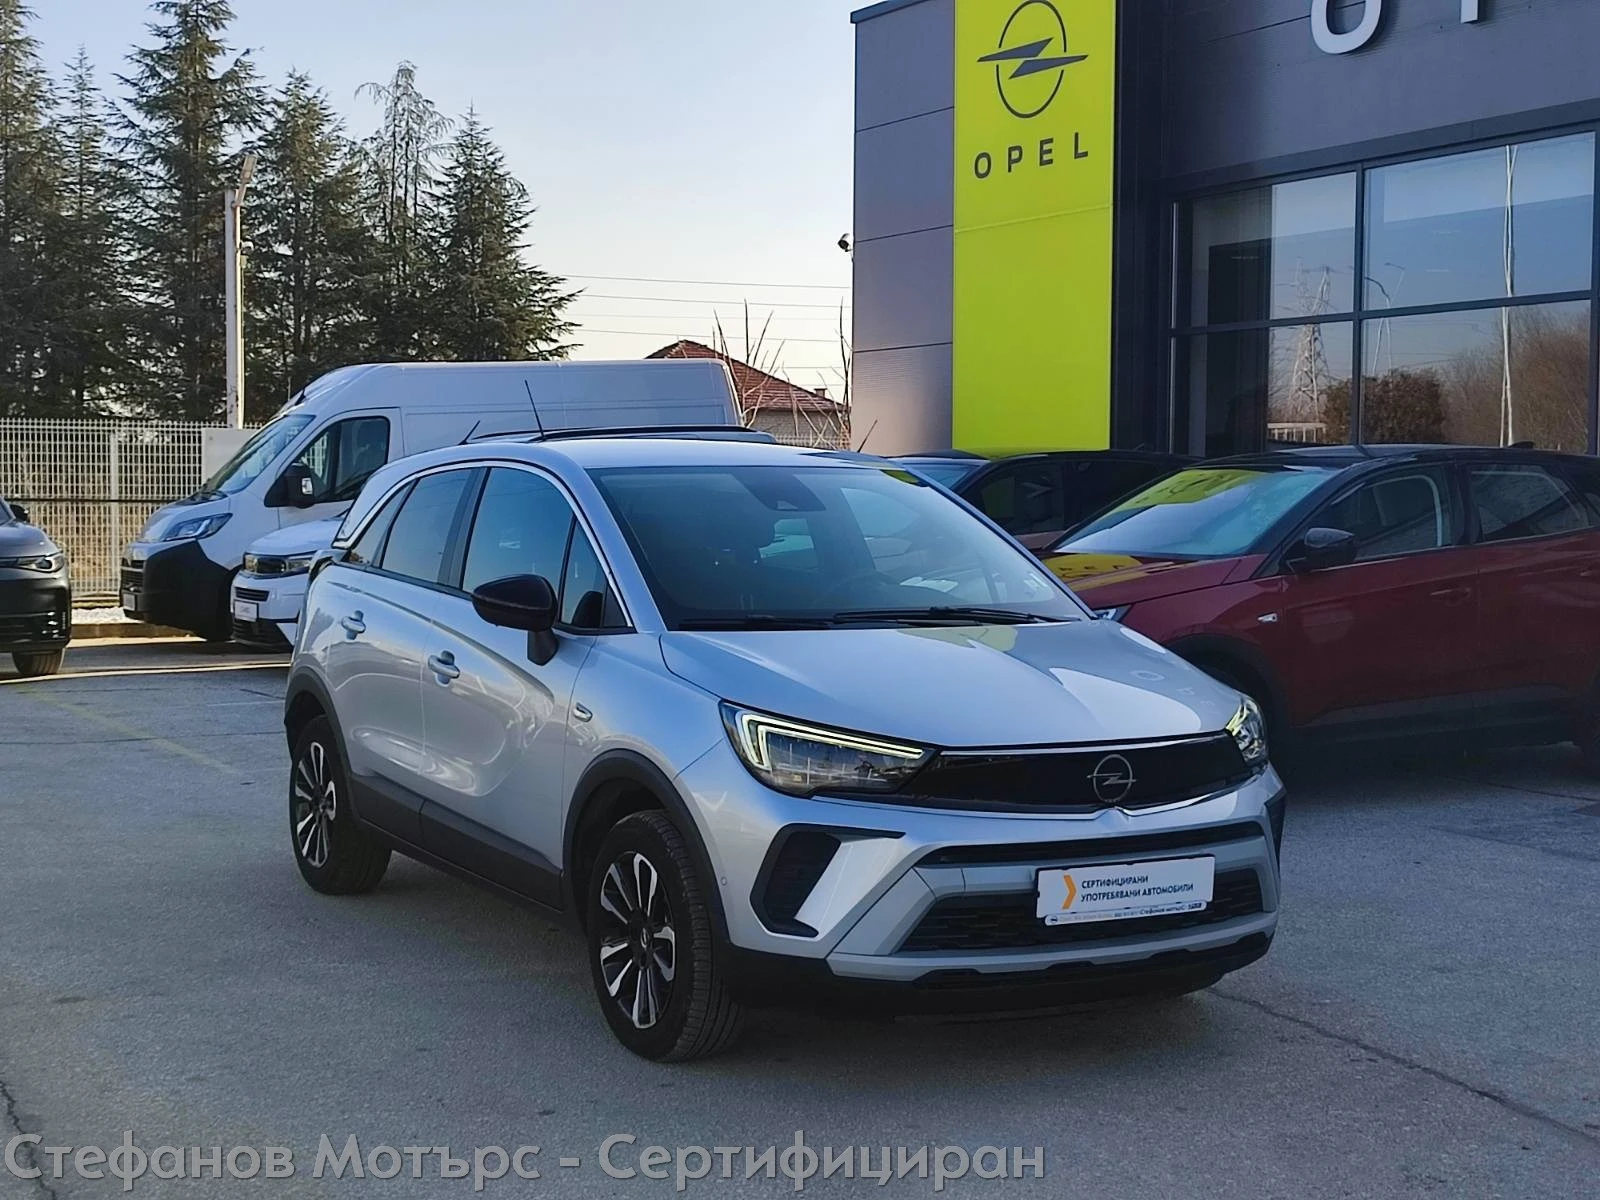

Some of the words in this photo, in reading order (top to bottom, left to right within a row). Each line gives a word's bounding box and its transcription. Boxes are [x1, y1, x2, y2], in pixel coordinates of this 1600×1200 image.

[973, 132, 1089, 180] OPEL
[1081, 875, 1149, 889] СЕРТИФИЦИРАНИ
[1081, 889, 1141, 902] УПОТРЕБЯВАНИ
[1142, 883, 1194, 896] АВТОМОБИЛИ
